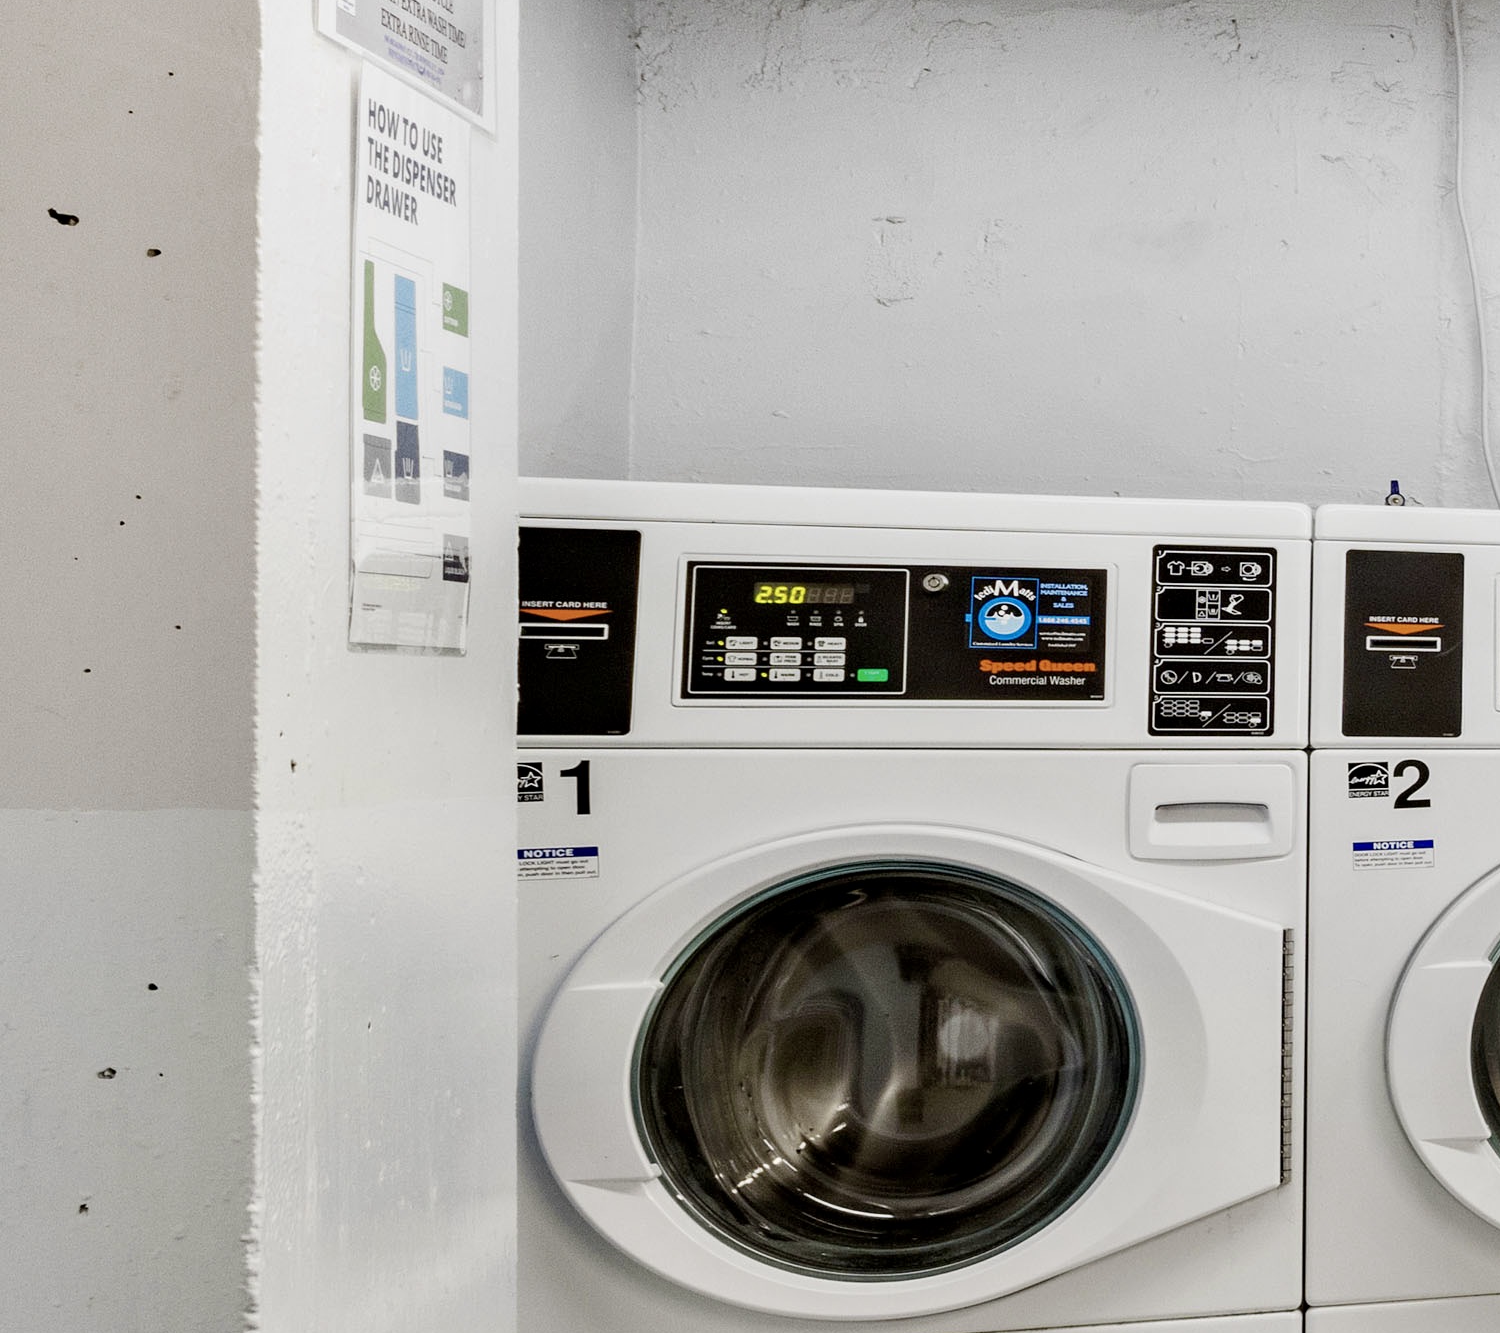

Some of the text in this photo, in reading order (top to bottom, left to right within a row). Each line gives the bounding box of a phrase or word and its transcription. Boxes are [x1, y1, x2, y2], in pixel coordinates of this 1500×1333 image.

[427, 8, 447, 37] WASH
[381, 7, 408, 40] EXTRA
[408, 24, 430, 53] RINSE
[430, 38, 448, 64] TIME
[368, 98, 443, 164] HOW TO USE
[367, 136, 457, 207] THE DISPENSER
[366, 174, 419, 226] DRAWER
[521, 600, 608, 609] INSERT CARD HERE
[754, 585, 806, 604] 2.50
[980, 659, 1096, 674] Speed Queen
[988, 675, 1086, 686] Commercial Washer
[560, 760, 591, 815] 1
[1373, 789, 1390, 797] STAR
[1393, 759, 1431, 809] 2
[523, 848, 574, 858] NOTICE
[1372, 840, 1415, 850] NOTICE
